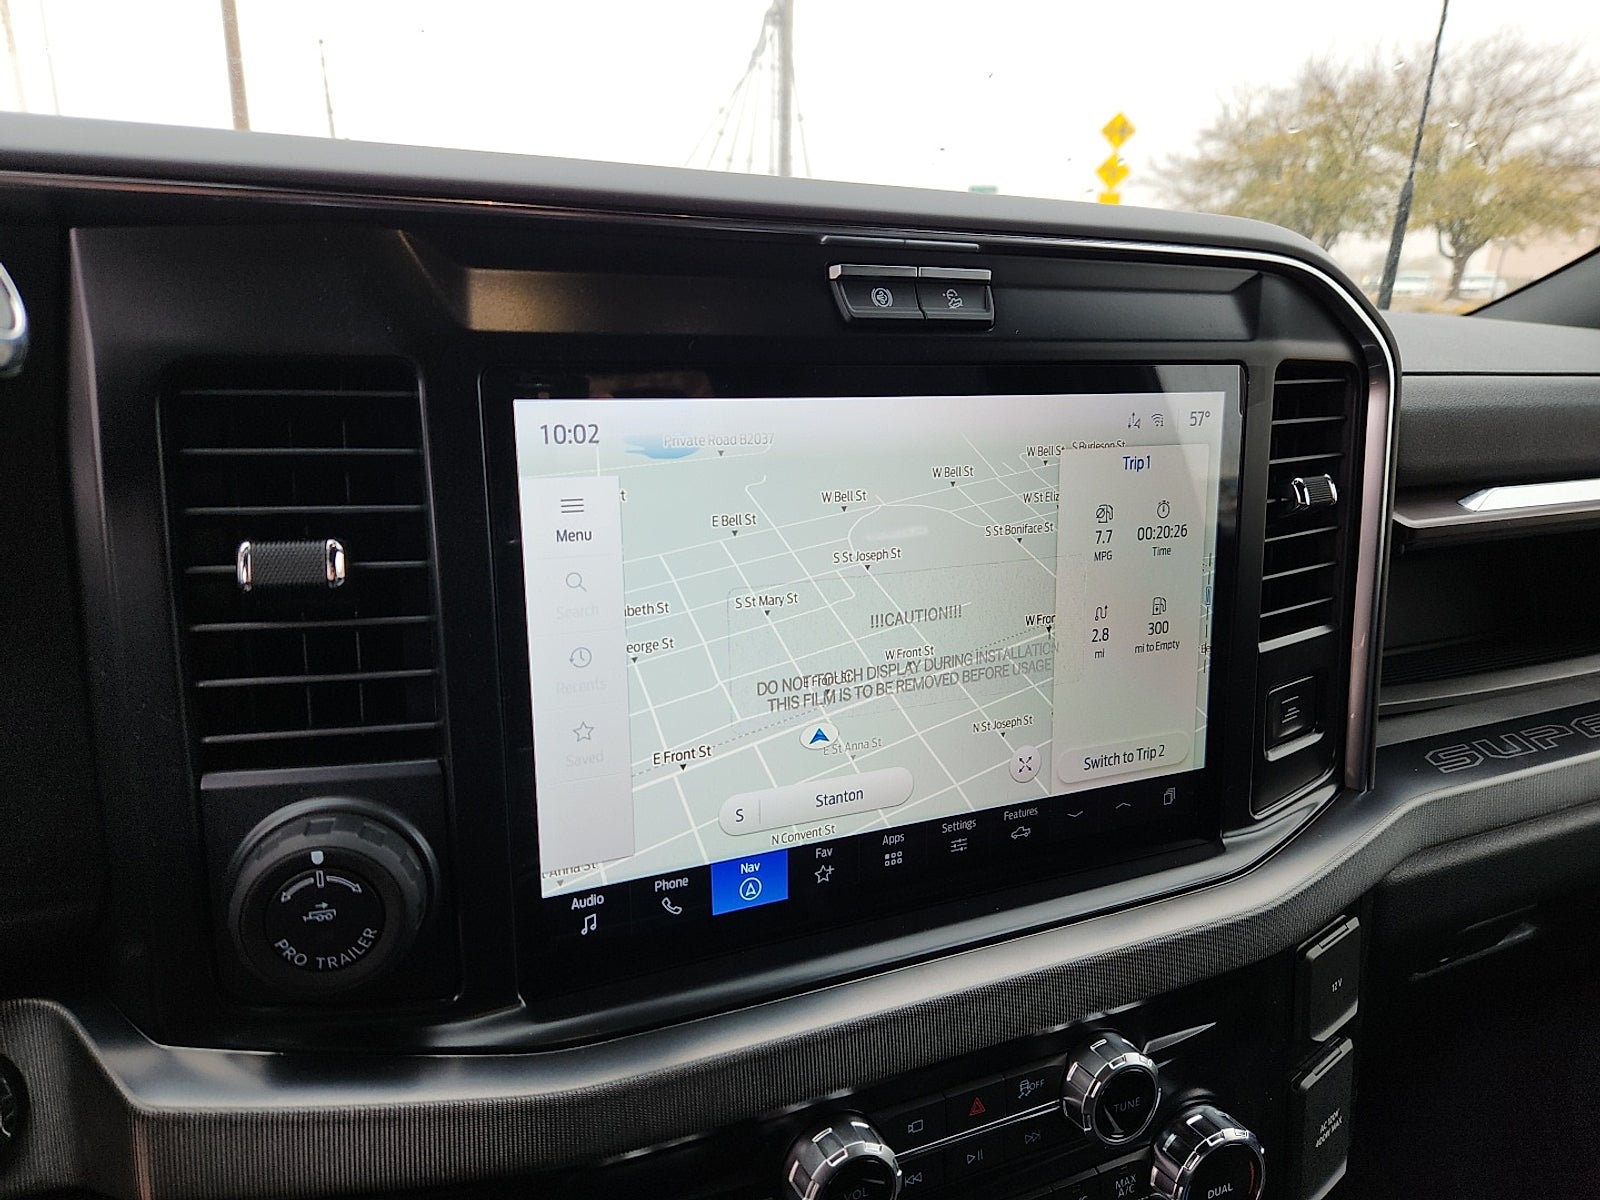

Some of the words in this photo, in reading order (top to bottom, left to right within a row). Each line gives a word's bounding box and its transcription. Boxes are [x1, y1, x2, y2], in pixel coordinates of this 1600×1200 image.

[1189, 410, 1210, 427] 57°
[540, 424, 599, 445] 10:02
[664, 435, 705, 447] Private
[708, 434, 736, 445] Road
[740, 433, 774, 445] B2037
[1027, 447, 1035, 457] W
[1037, 446, 1053, 456] Bell
[1123, 456, 1145, 472] Trip
[1146, 455, 1151, 469] 1
[932, 467, 942, 478] W
[944, 466, 961, 477] Bell
[963, 466, 974, 477] St
[821, 491, 832, 503] W
[834, 491, 854, 502] Bell
[855, 490, 867, 501] St
[1023, 493, 1032, 503] W
[1034, 492, 1043, 503] St
[712, 515, 719, 527] E
[721, 514, 742, 527] Bell
[744, 513, 757, 526] St
[556, 529, 593, 543] Menu
[985, 525, 992, 537] S
[993, 525, 1003, 536] St
[1005, 523, 1043, 535] Boniface
[1044, 522, 1054, 533] St
[1095, 530, 1113, 544] 7.7
[1137, 524, 1188, 541] 00:20:26
[833, 552, 840, 564] S
[842, 552, 853, 562] St
[855, 549, 889, 563] Joseph
[890, 548, 901, 559] St
[1093, 550, 1113, 561] MPG
[1152, 546, 1172, 557] Time
[657, 602, 669, 615] St
[735, 597, 742, 609] S
[744, 596, 757, 608] St
[758, 594, 785, 608] Mary
[787, 593, 798, 604] St
[870, 605, 962, 628] !!!CAUTION!!!
[1025, 614, 1036, 626] W
[1091, 628, 1110, 643] 2.8
[1147, 621, 1169, 636] 300
[626, 640, 660, 654] eorge
[662, 638, 674, 650] St
[885, 650, 895, 660] W
[896, 647, 923, 658] Front
[924, 645, 935, 656] St
[1134, 644, 1145, 654] mi
[1146, 643, 1155, 653] to
[1155, 640, 1181, 652] Empty
[1094, 649, 1105, 659] mi
[757, 680, 779, 696] DO
[782, 674, 811, 692] NOT
[866, 660, 922, 681] DISPLAY
[924, 653, 973, 672] DURING
[976, 643, 1060, 664] INSTALLATION
[767, 695, 800, 713] THIS
[803, 689, 836, 707] FILM
[839, 687, 852, 702] IS
[854, 684, 873, 699] TO
[876, 682, 894, 697] BE
[896, 673, 959, 694] REMOVED
[962, 664, 1010, 684] BEFORE
[1012, 658, 1054, 676] USAGE
[973, 722, 980, 733] N
[981, 720, 991, 732] St
[993, 716, 1023, 730] Joseph
[1023, 715, 1033, 726] St
[823, 746, 830, 756] E
[831, 743, 843, 755] St
[845, 740, 869, 752] Anna
[871, 738, 883, 749] St
[653, 752, 661, 765] E
[663, 748, 695, 764] Front
[698, 745, 712, 760] St
[1083, 752, 1121, 771] Switch
[1123, 751, 1135, 764] to
[1136, 746, 1157, 762] Trip
[1158, 744, 1165, 758] 2
[815, 788, 864, 808] Stanton
[735, 808, 745, 823] S
[1003, 806, 1039, 821] Features
[941, 818, 977, 834] Settings
[771, 834, 780, 846] N
[781, 826, 822, 844] Convent
[824, 824, 836, 836] St
[882, 833, 905, 846] Apps
[815, 847, 833, 859] Fav
[740, 861, 761, 875] Nav
[654, 876, 689, 893] Phone
[571, 893, 605, 910] Audio
[274, 938, 308, 967] PRO
[316, 926, 378, 970] TRAILER
[1029, 1078, 1046, 1092] OFF
[1113, 1096, 1141, 1113] TUNE
[1115, 1174, 1137, 1189] MAX
[843, 1186, 869, 1200] VOL
[1117, 1185, 1136, 1199] A/C
[1207, 1182, 1234, 1200] DUAL
